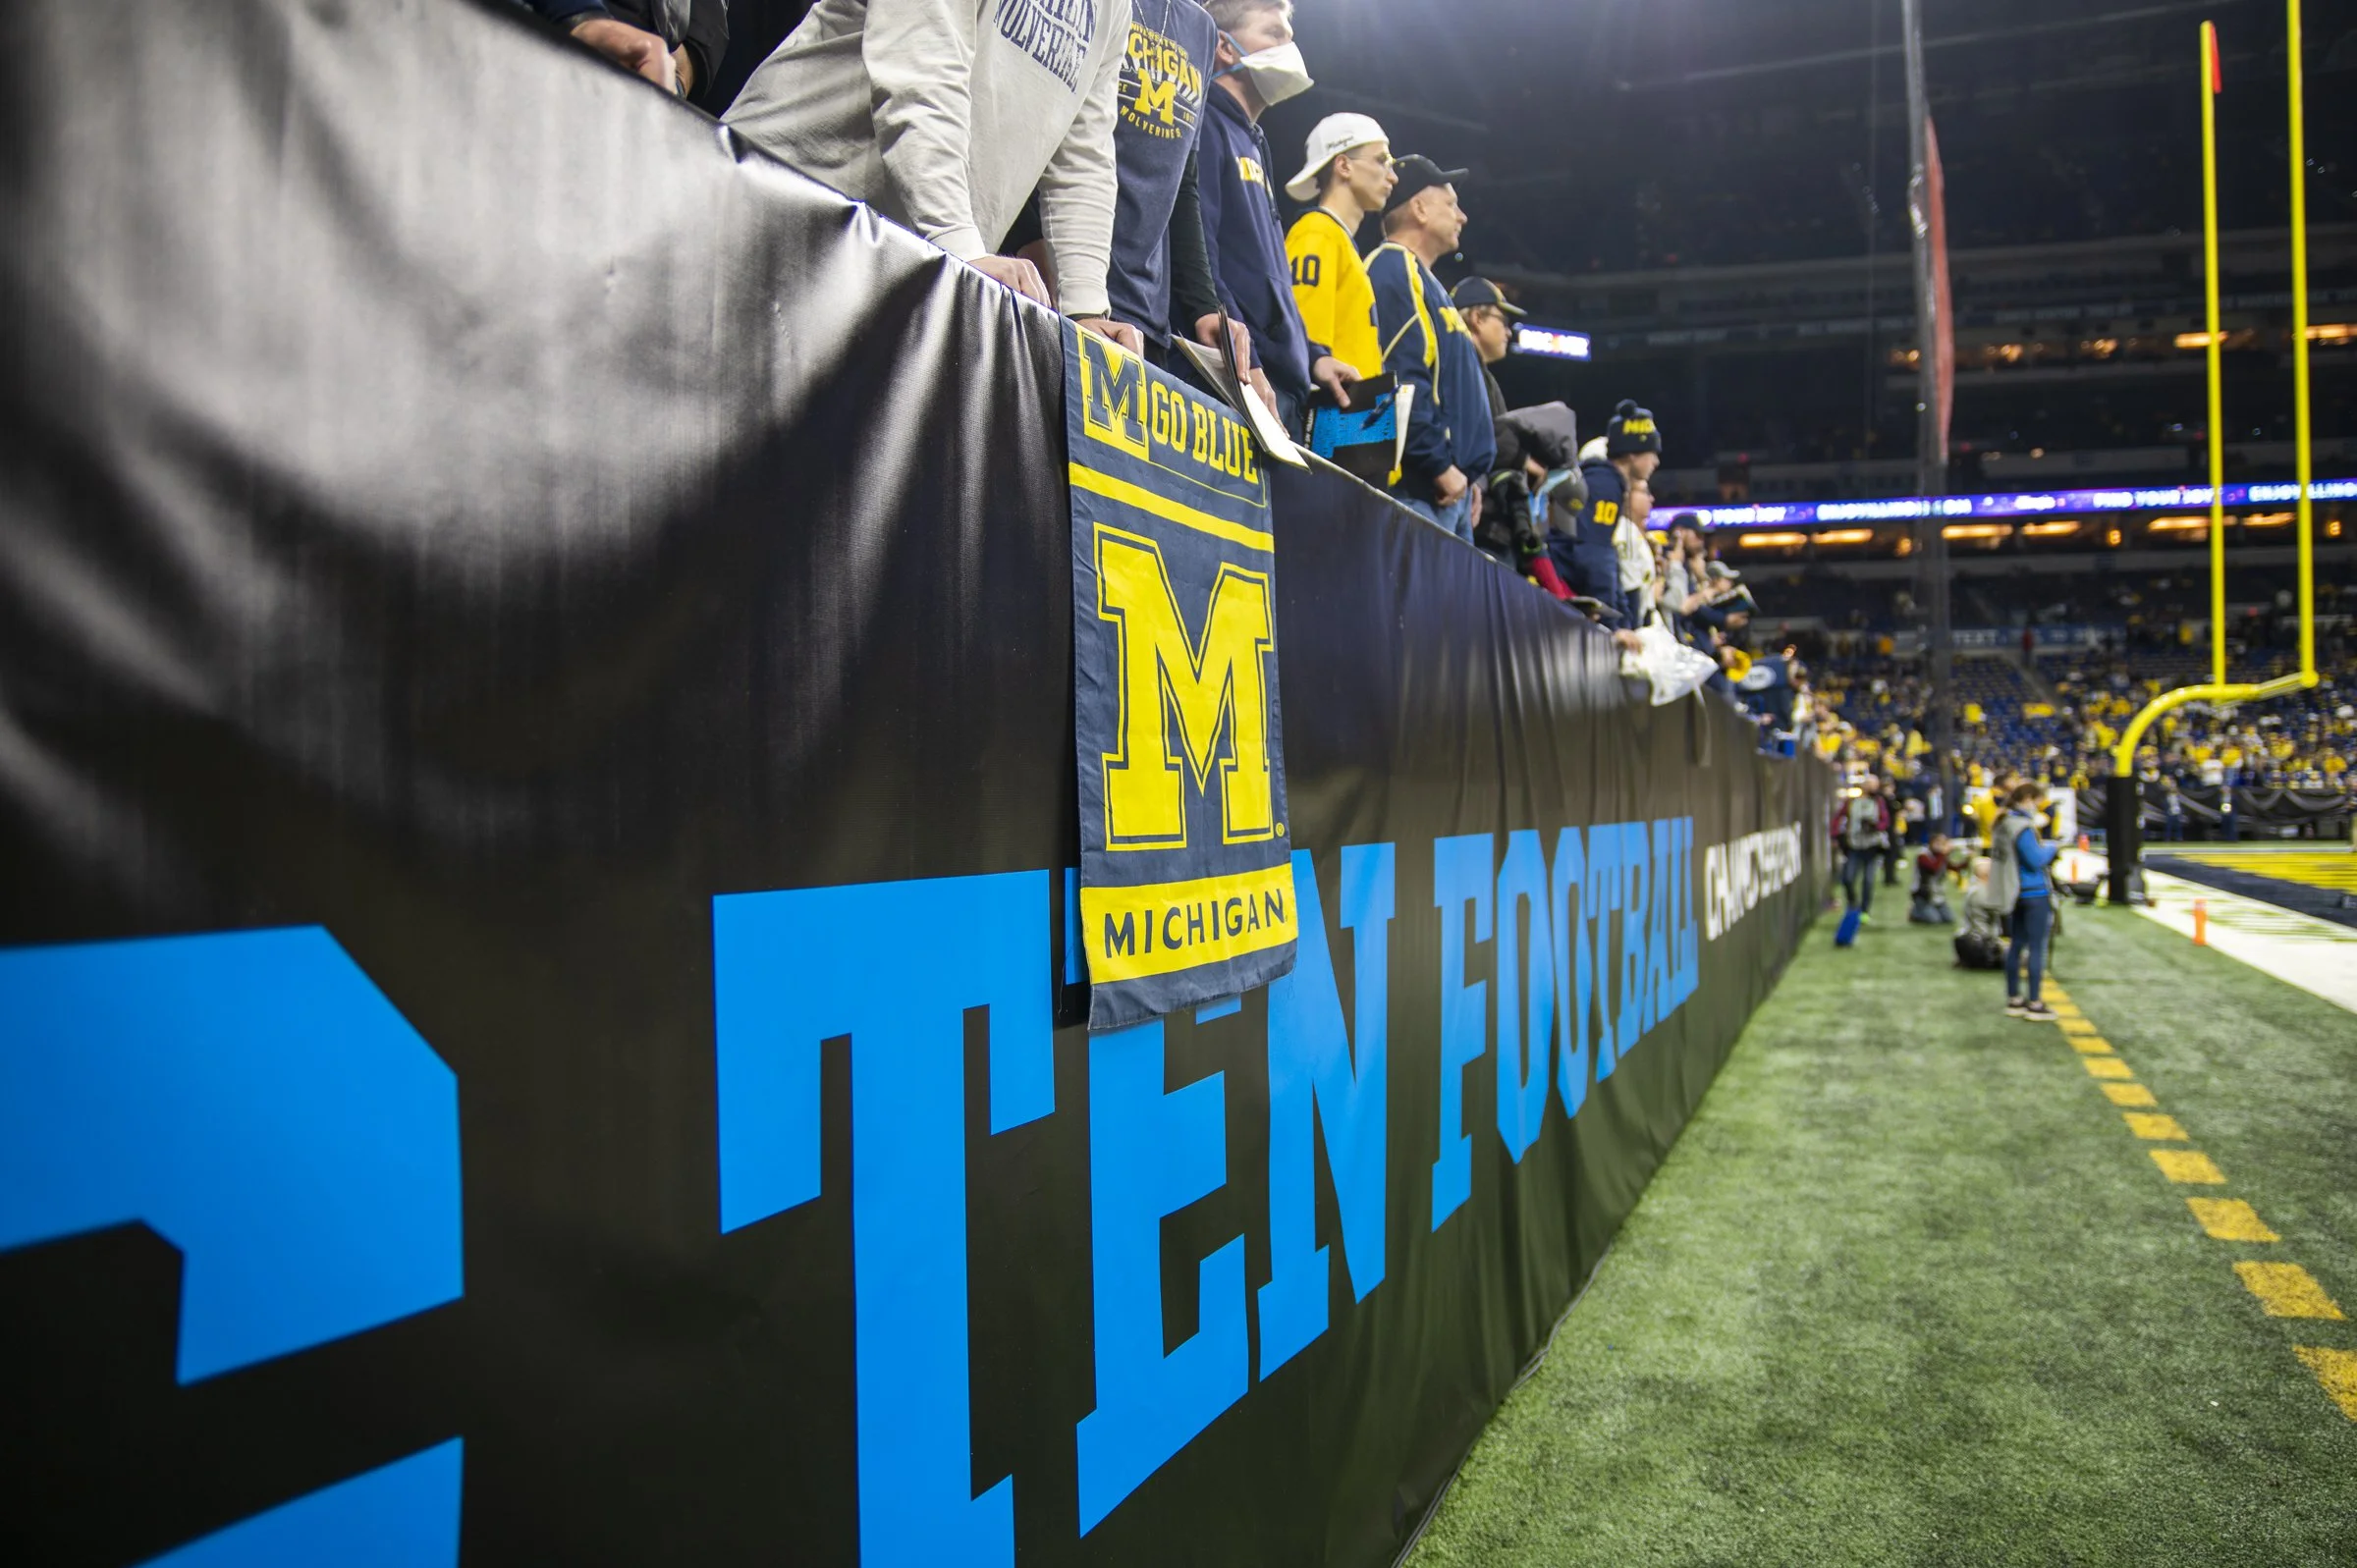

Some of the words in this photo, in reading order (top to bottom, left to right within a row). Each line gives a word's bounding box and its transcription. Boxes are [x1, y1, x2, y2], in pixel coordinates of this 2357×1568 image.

[1120, 105, 1181, 138] WOLVERINES
[1133, 67, 1177, 126] M
[1290, 253, 1320, 288] 10
[1081, 331, 1146, 448] M
[1151, 380, 1187, 454] GO
[1191, 400, 1259, 485] BLUE
[1593, 500, 1619, 525] 10
[1092, 521, 1275, 851] M
[1104, 888, 1286, 959] MICHIGAN
[713, 841, 1396, 1568] TEN
[1432, 815, 1700, 1234] FOOTBALL
